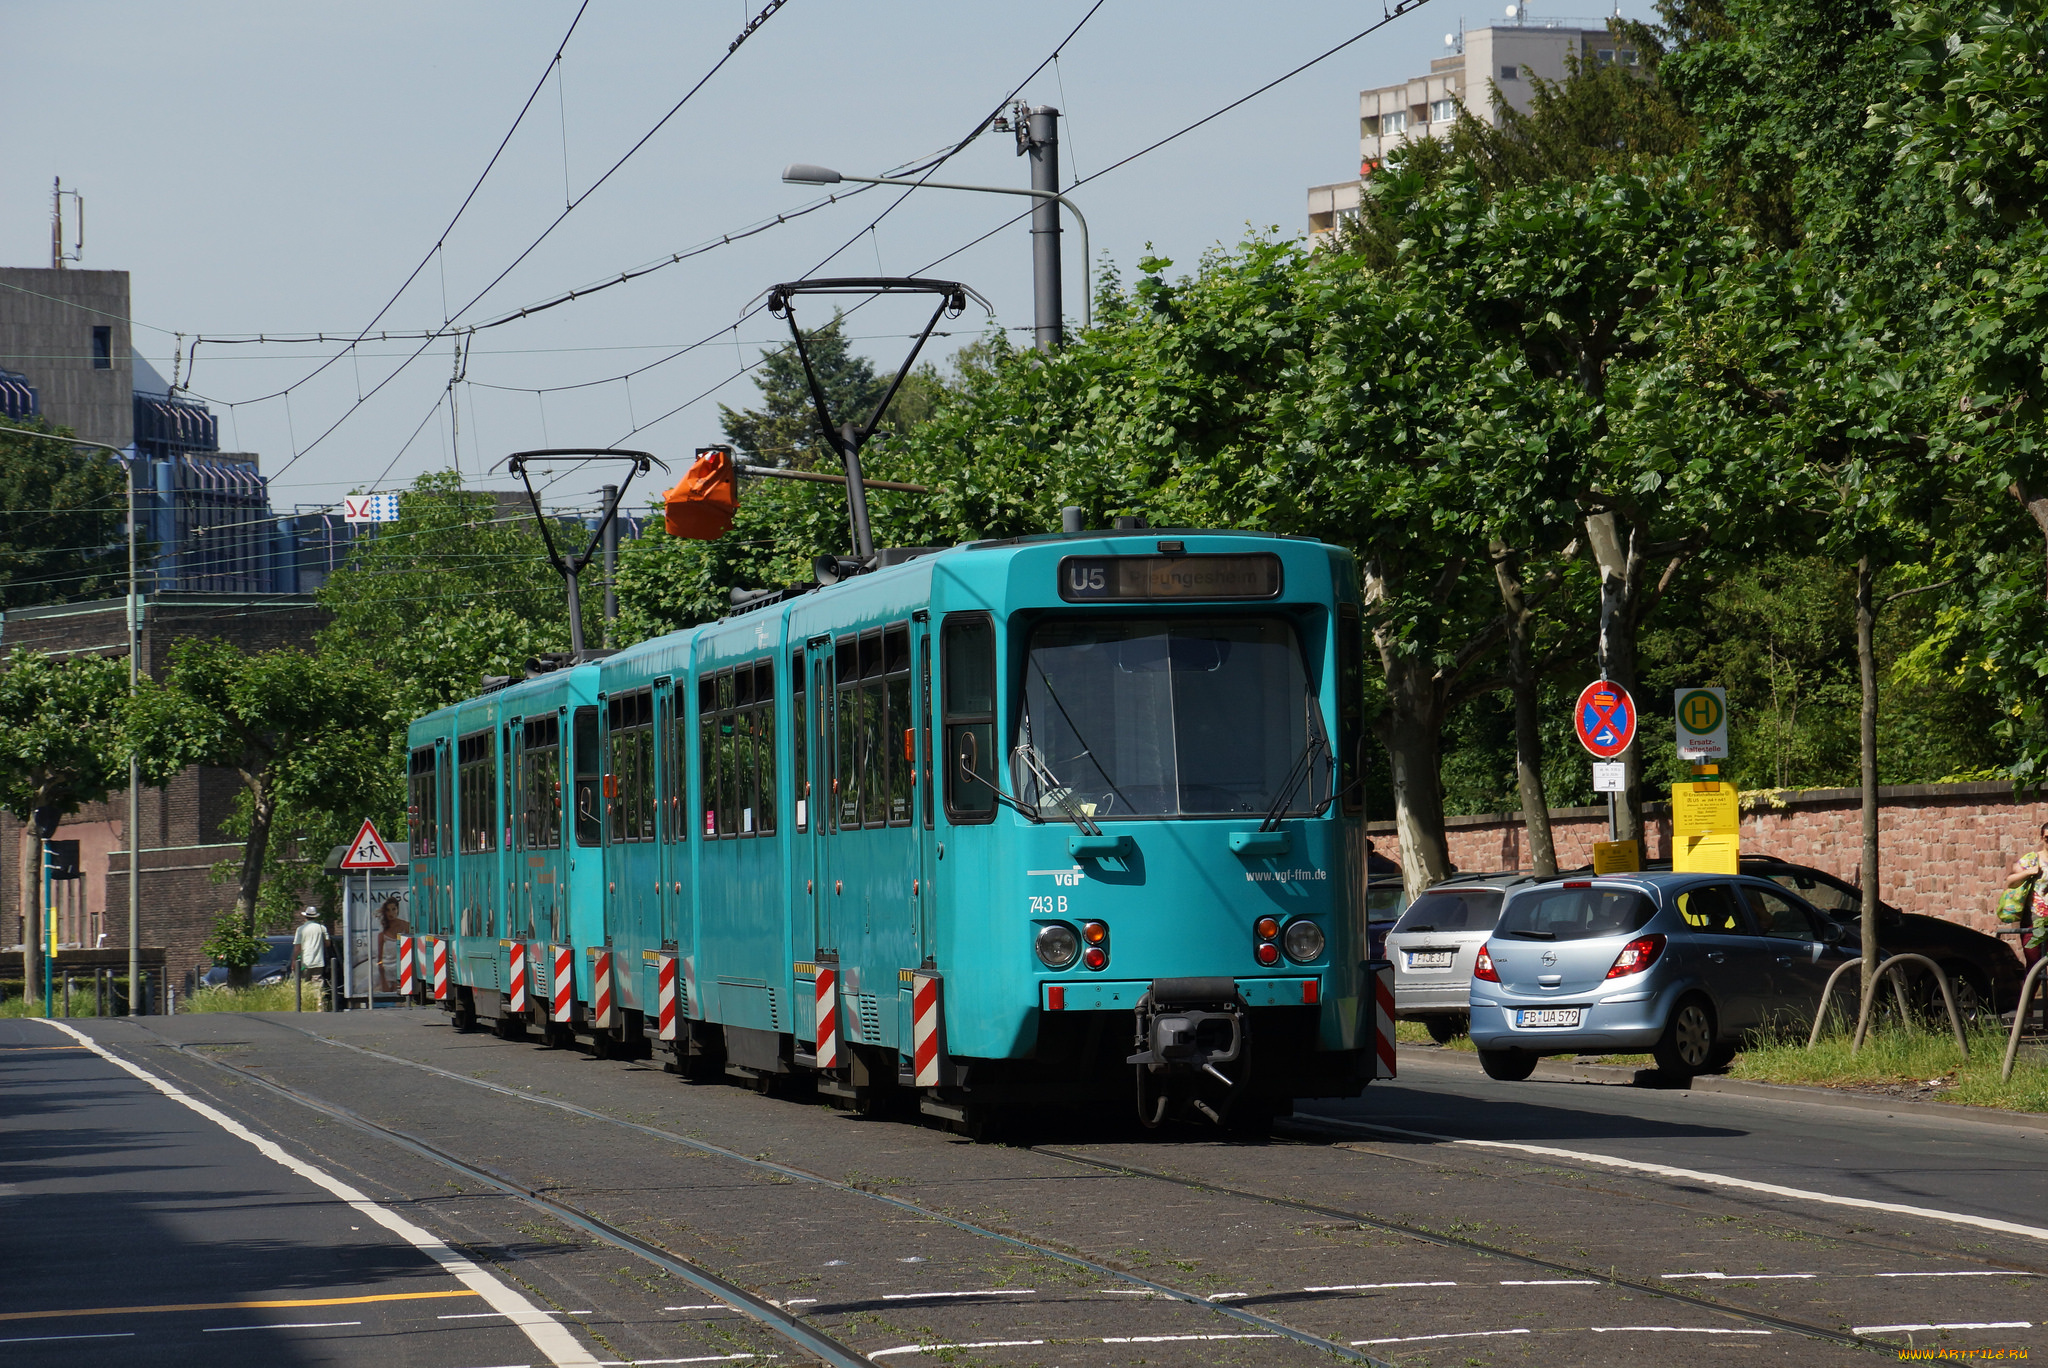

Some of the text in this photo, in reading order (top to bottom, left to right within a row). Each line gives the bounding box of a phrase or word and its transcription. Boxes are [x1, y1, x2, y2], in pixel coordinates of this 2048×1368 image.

[1070, 568, 1105, 590] U5
[1691, 700, 1710, 725] H
[1054, 868, 1085, 886] VGF
[1245, 868, 1327, 883] www.vgf-ffm.de
[1028, 895, 1068, 913] 743 B
[1523, 1010, 1578, 1022] FB UA 579
